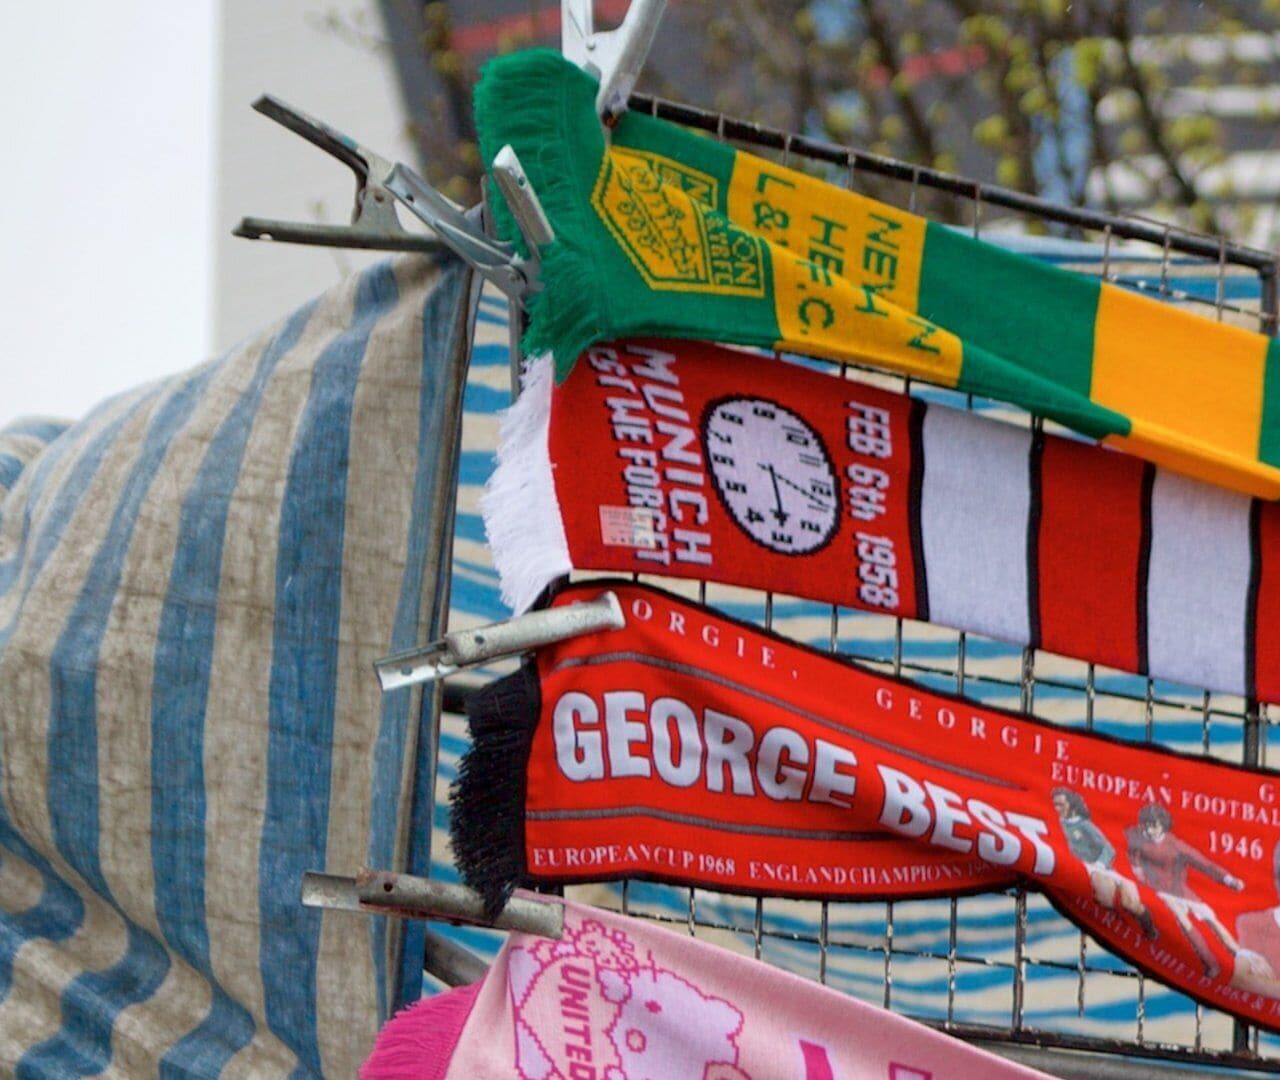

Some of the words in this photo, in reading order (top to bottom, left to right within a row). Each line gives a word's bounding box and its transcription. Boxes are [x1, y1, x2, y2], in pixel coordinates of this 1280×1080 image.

[603, 396, 653, 444] WE
[843, 401, 890, 459] FEB
[627, 344, 713, 566] MUNICH
[844, 466, 890, 522] 6th
[854, 531, 899, 607] 1958
[875, 687, 1072, 763] GEORGIE
[551, 690, 858, 810] GEORGE
[876, 762, 1058, 879] BEST
[1050, 760, 1172, 806] EUROPEAN
[532, 842, 652, 867] EUROPEAN
[652, 845, 696, 870] CUP
[697, 851, 737, 876] 1968
[748, 860, 849, 885] ENGLAND
[1207, 829, 1264, 861] 1946
